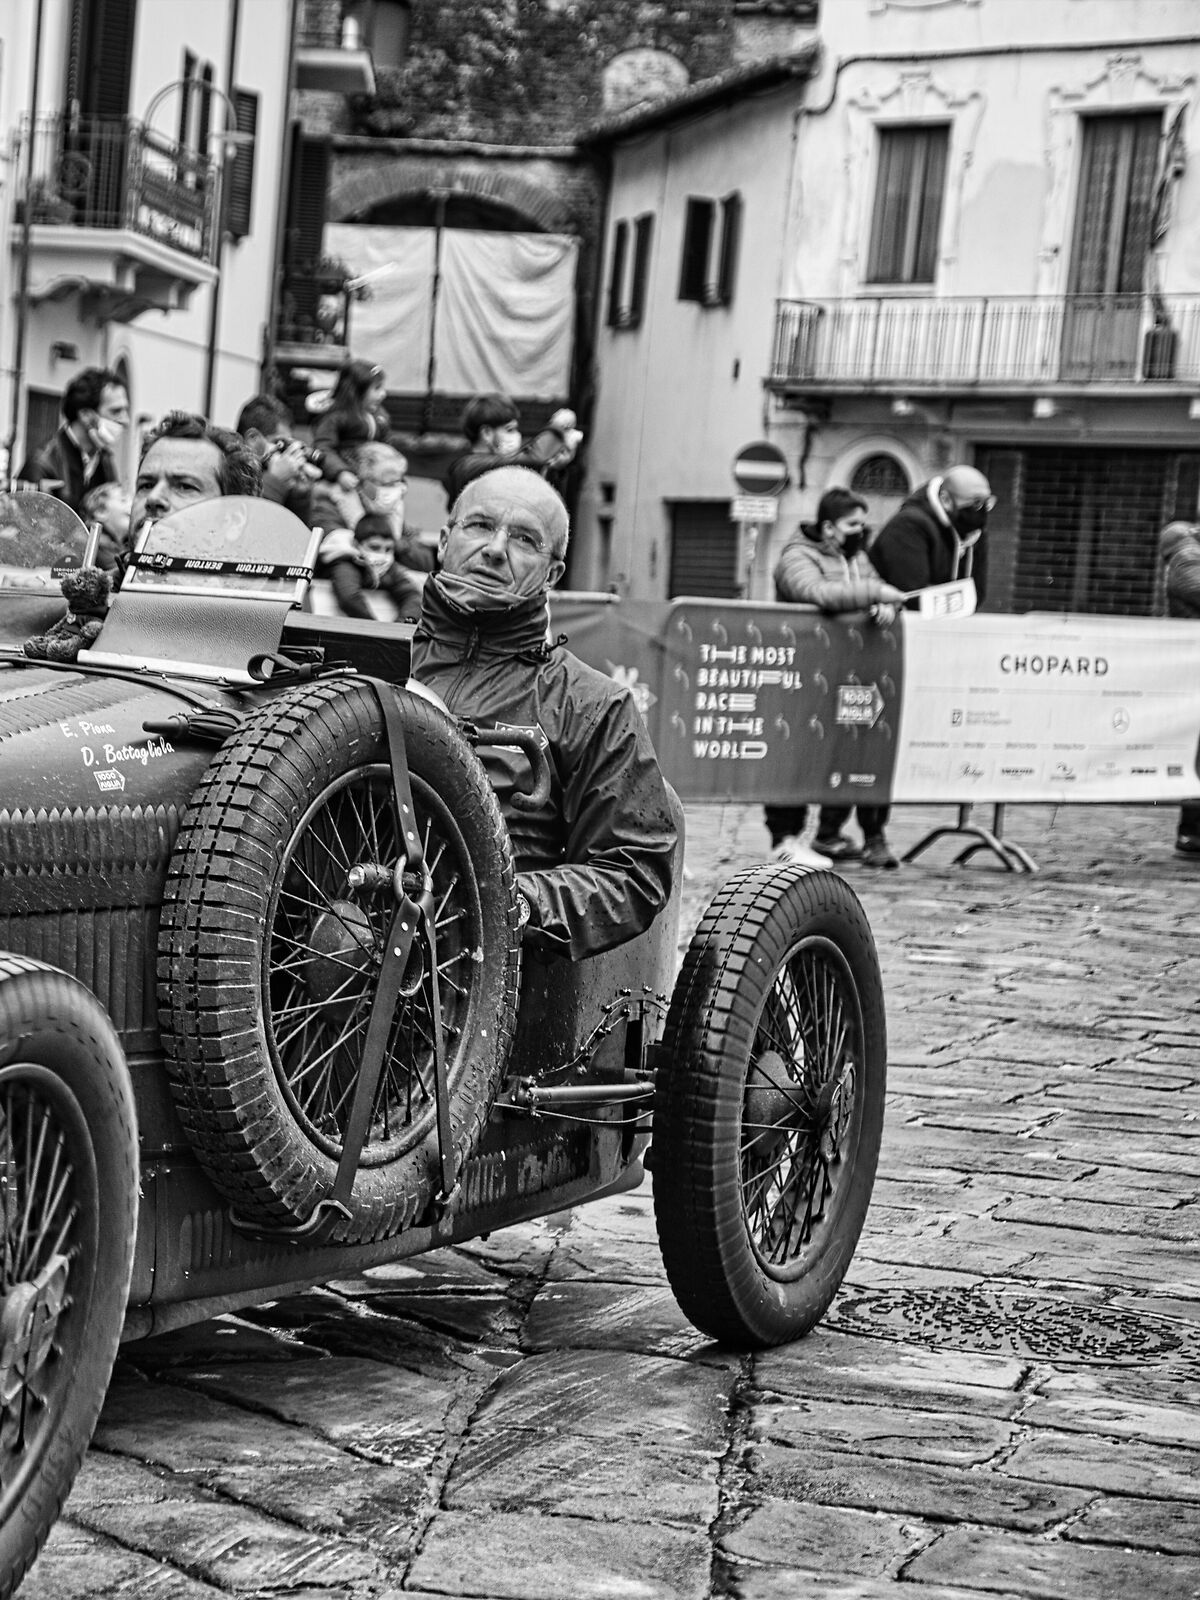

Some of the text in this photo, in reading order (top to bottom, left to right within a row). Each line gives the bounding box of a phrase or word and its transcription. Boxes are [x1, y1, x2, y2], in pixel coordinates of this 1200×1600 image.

[185, 559, 223, 571] BERTONI
[235, 563, 275, 575] BERTONI
[700, 644, 796, 666] THE MOST
[1000, 654, 1108, 676] CHOPARD
[697, 669, 802, 690] BEAUTIFUL
[695, 692, 757, 712] RACE
[60, 722, 78, 738] E.
[694, 716, 765, 735] IN THE
[81, 736, 175, 767] D. Battagliola
[692, 741, 768, 759] WORLD
[97, 771, 116, 781] 1000
